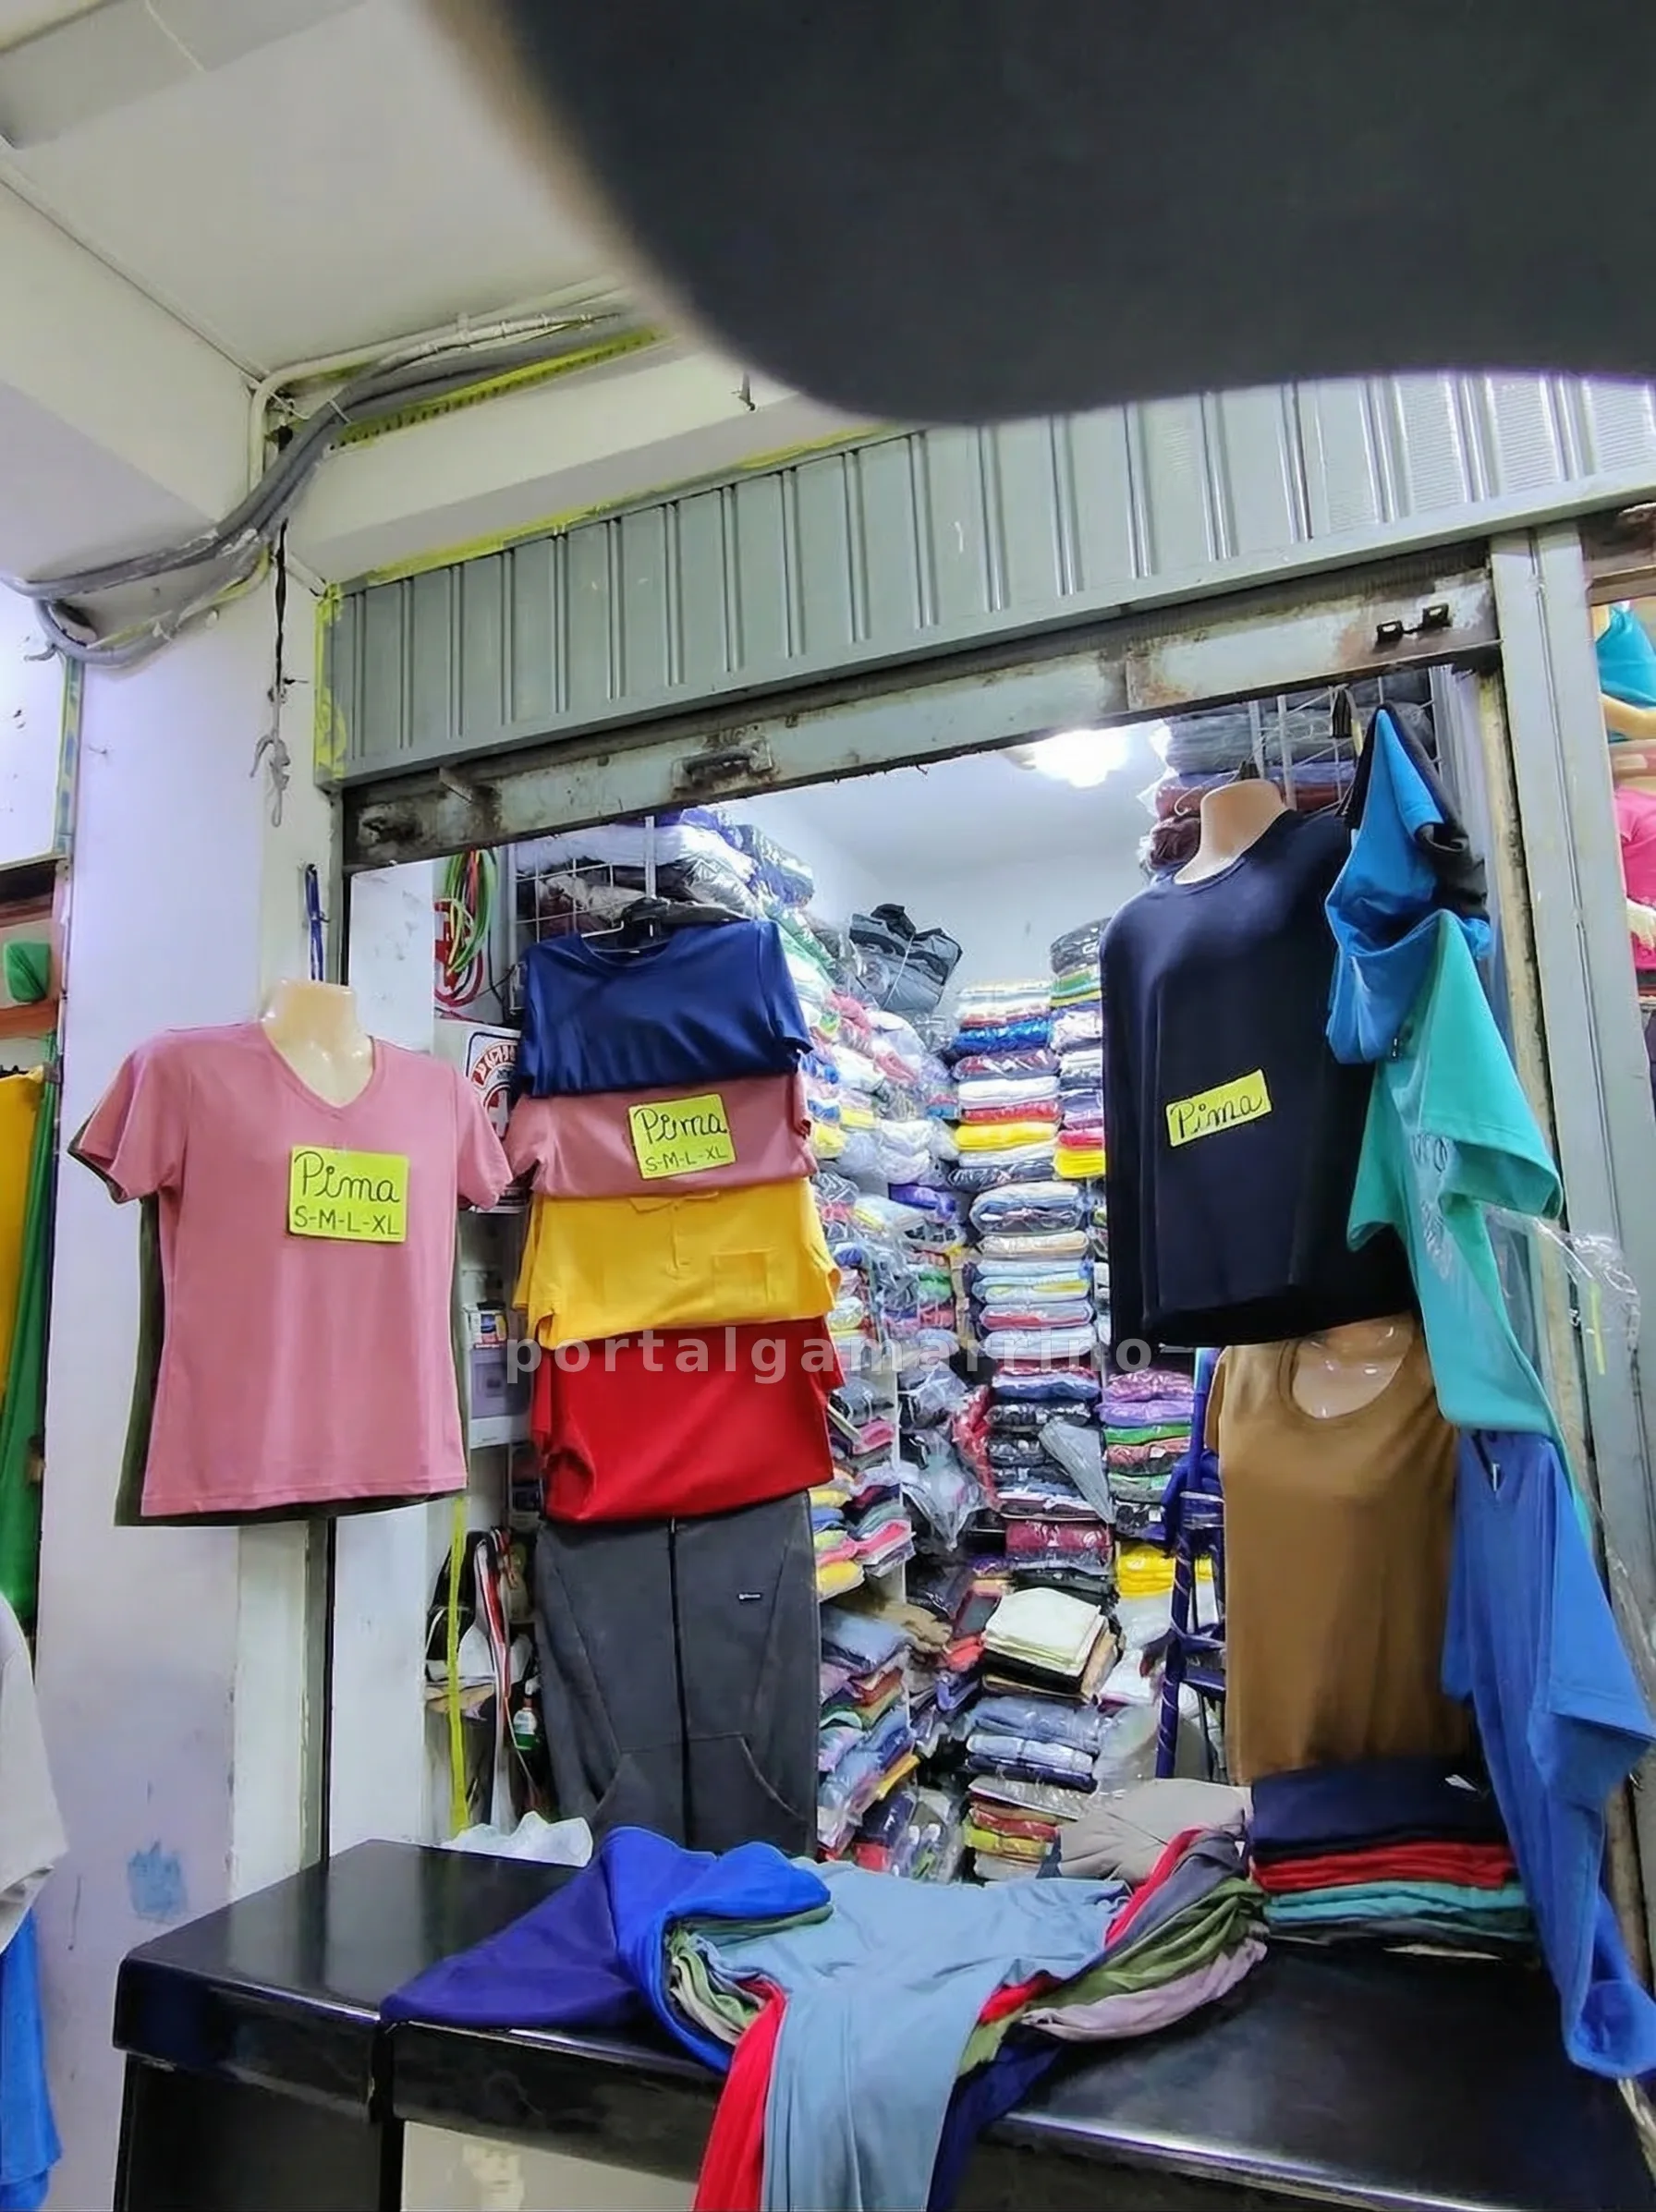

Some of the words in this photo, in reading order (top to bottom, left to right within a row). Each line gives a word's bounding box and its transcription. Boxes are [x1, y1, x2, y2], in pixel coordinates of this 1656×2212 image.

[633, 1107, 728, 1145] Pima
[1169, 1095, 1263, 1139] Pima
[294, 1150, 400, 1203] Pima
[293, 1205, 401, 1235] S-M-L-XL
